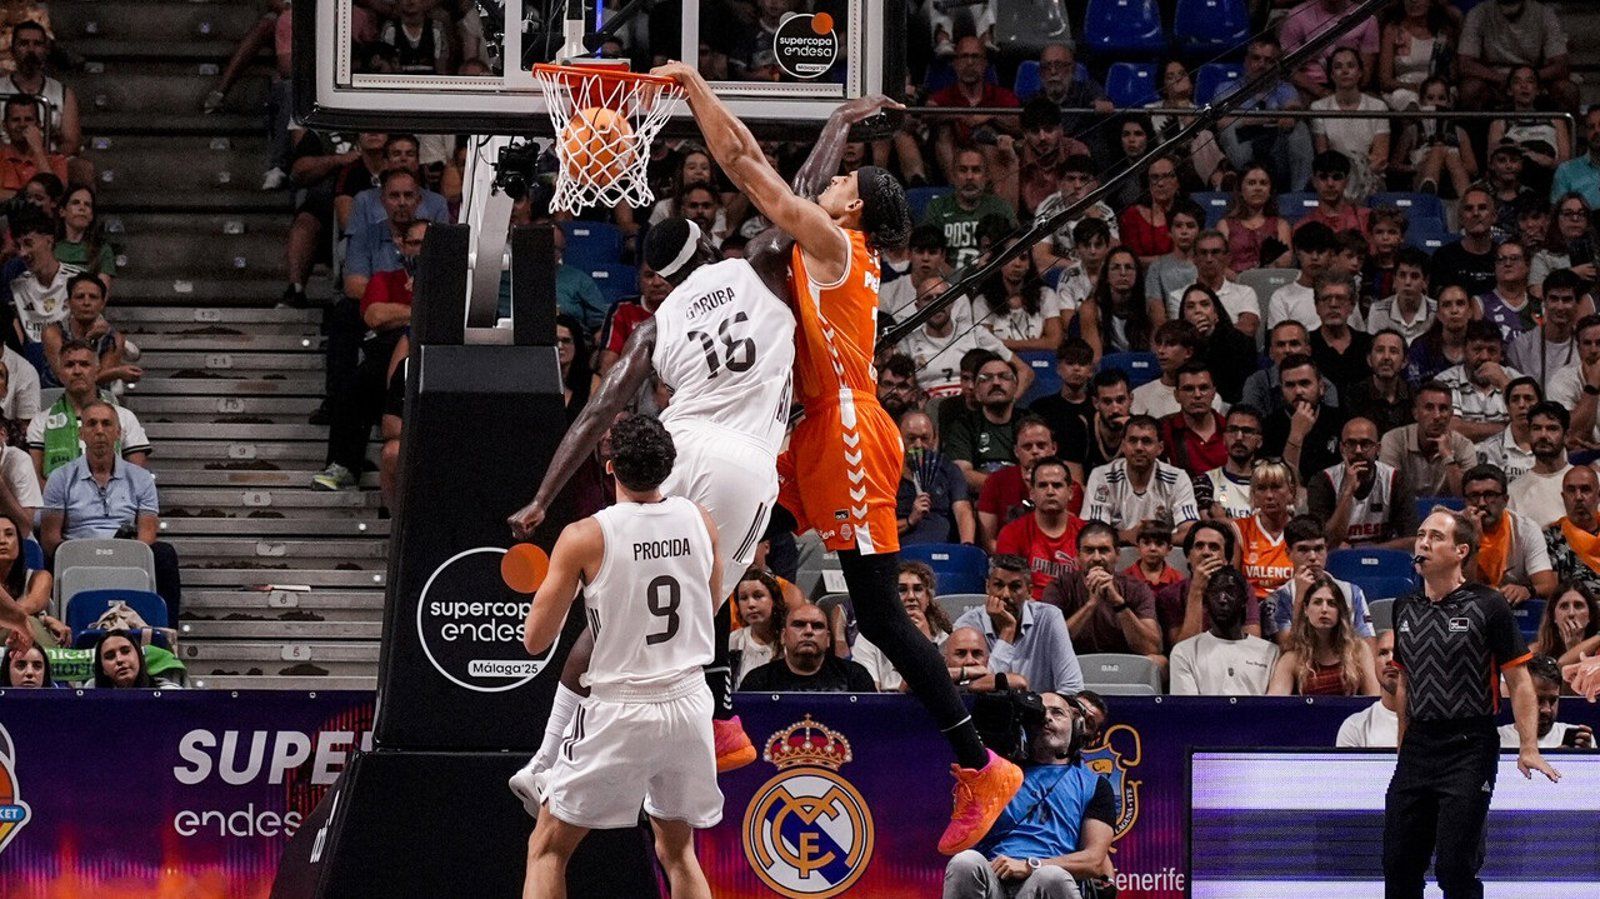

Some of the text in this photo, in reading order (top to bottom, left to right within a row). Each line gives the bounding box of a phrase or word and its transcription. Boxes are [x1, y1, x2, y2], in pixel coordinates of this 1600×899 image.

[779, 37, 833, 46] supercopa
[784, 45, 833, 57] endesa
[944, 221, 979, 247] BOST
[685, 286, 736, 320] GARUBA
[687, 311, 756, 380] 16
[633, 538, 691, 561] PROCIDA
[1246, 565, 1295, 580] VALENCI
[430, 602, 533, 619] supercop
[646, 575, 681, 645] 9
[441, 618, 526, 642] endes
[473, 663, 539, 675] Málaga'25
[0, 808, 18, 819] KET
[174, 803, 303, 837] endes
[1113, 867, 1185, 891] enerife
